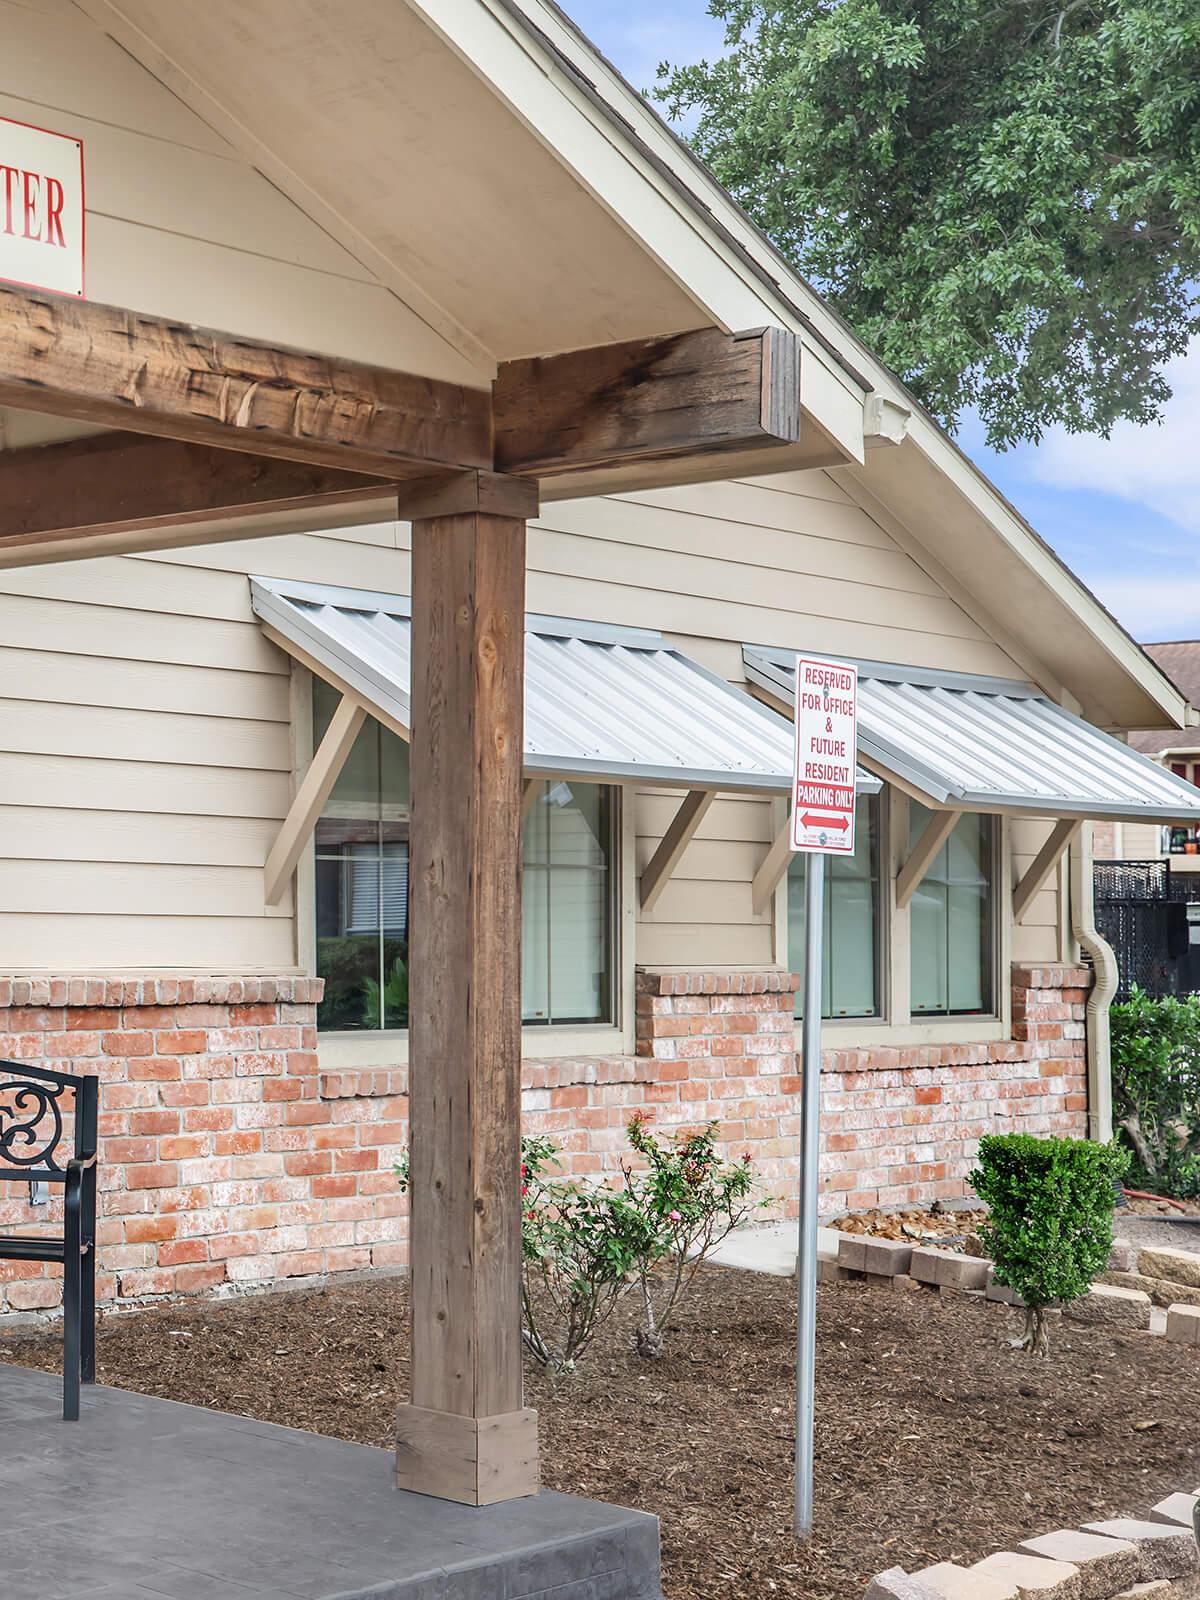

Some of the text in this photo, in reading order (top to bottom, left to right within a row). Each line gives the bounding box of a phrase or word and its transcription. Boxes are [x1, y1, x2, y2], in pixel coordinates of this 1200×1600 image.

[805, 667, 852, 690] RESERVED
[802, 693, 854, 716] FOR OFFICE
[825, 716, 833, 733] &
[811, 737, 846, 758] FUTURE
[805, 762, 850, 783] RESIDENT
[798, 785, 855, 809] PARKING ONLY
